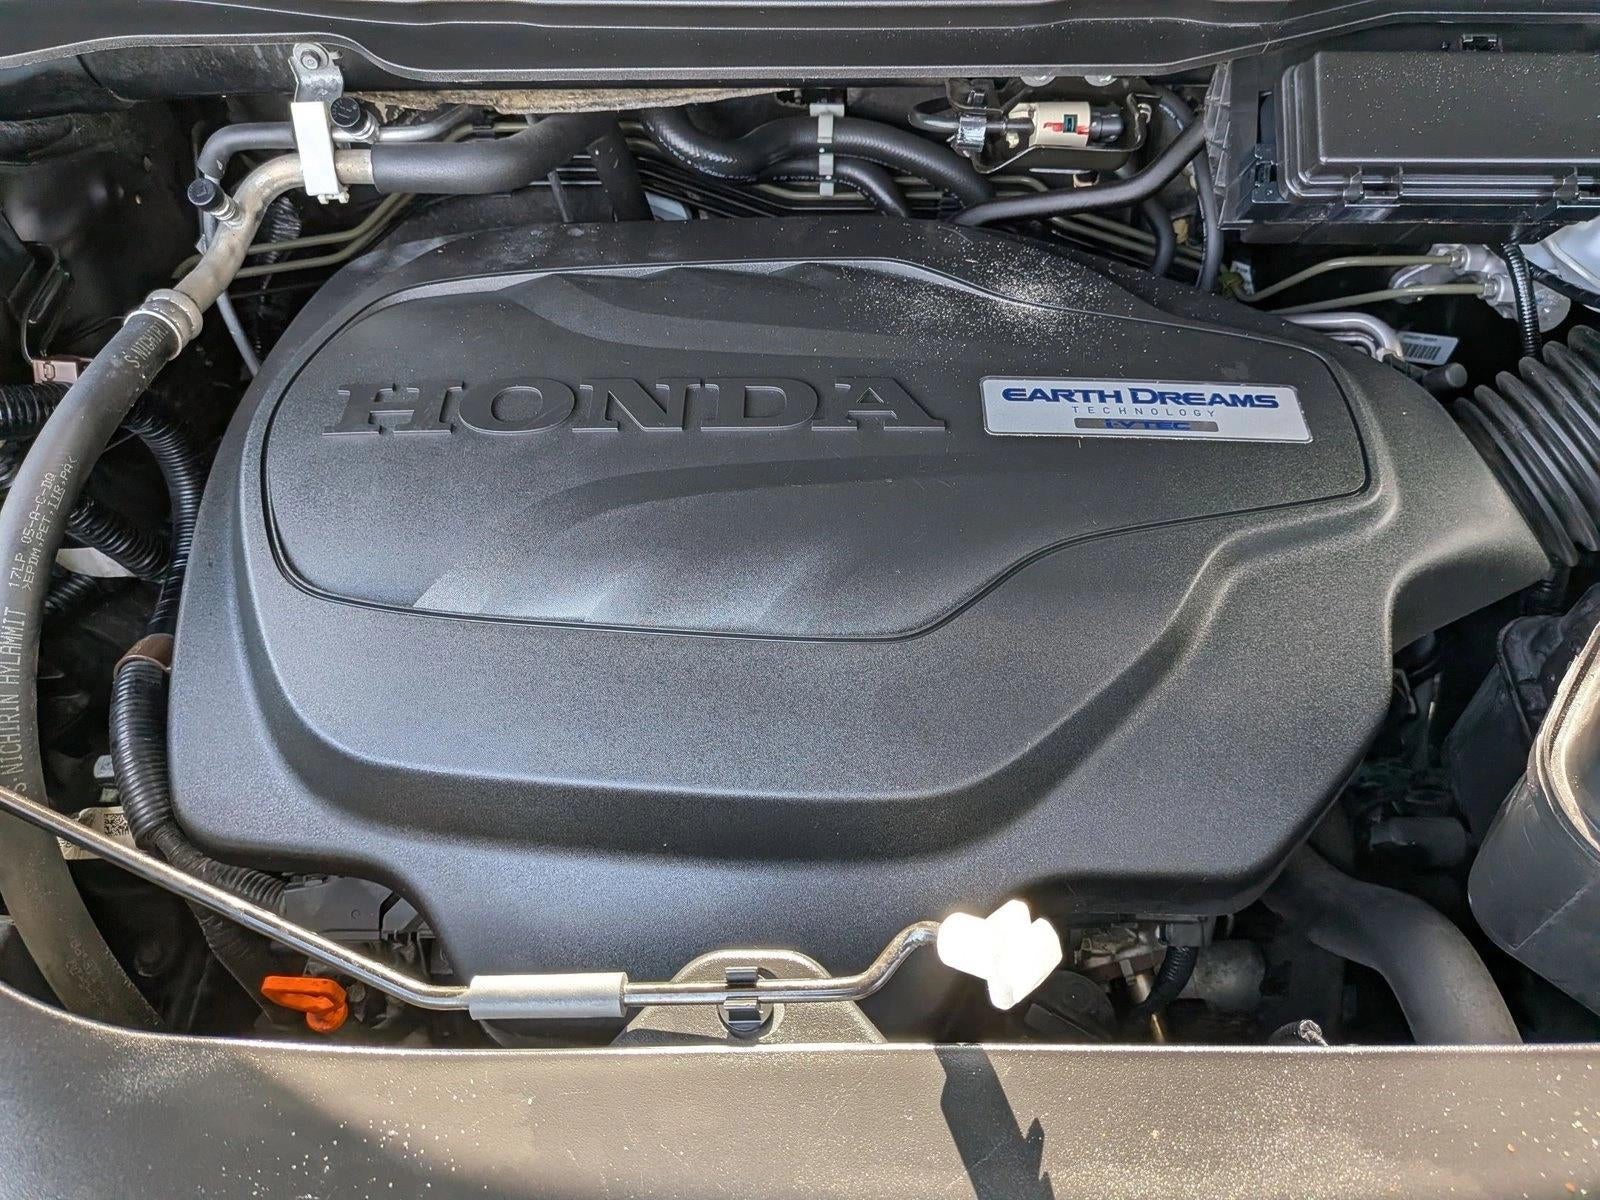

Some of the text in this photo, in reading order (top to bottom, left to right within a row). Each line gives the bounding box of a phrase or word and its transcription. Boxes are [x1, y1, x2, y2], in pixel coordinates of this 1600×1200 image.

[322, 375, 946, 436] HONDA
[1001, 387, 1280, 409] EARTH DREAMS
[1071, 405, 1216, 418] TECHNOLOGY
[8, 552, 27, 588] 17LP
